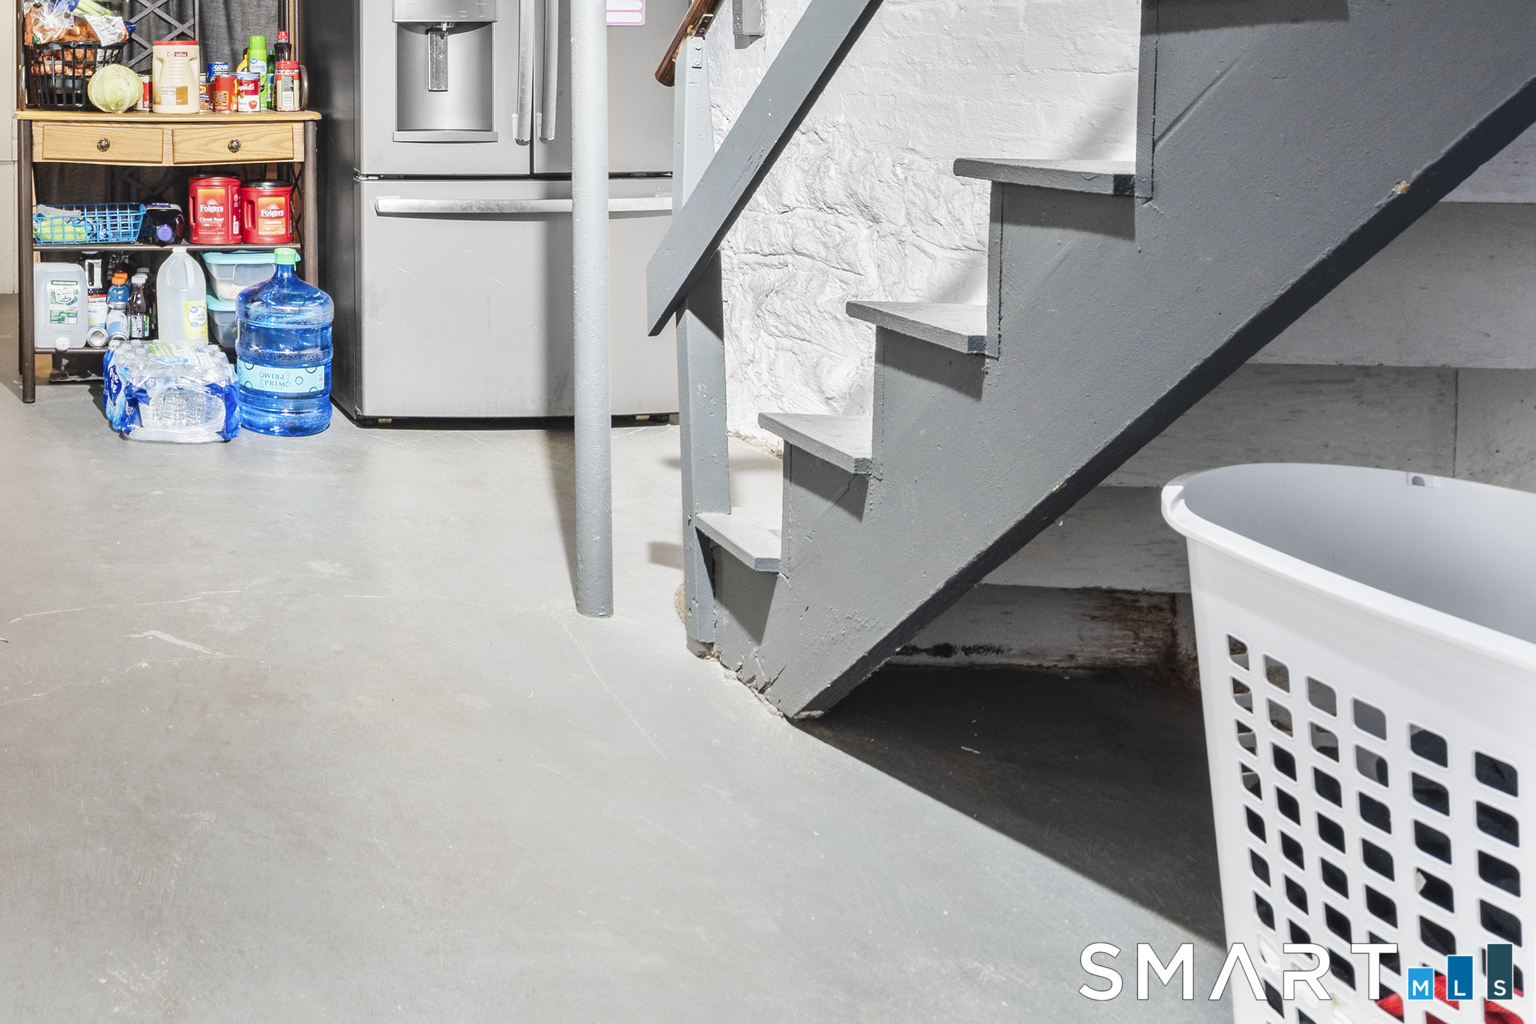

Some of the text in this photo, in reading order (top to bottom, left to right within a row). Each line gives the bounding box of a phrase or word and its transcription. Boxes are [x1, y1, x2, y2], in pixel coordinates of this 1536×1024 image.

[199, 204, 224, 213] Folgers
[260, 208, 284, 217] Folgers
[265, 379, 291, 387] PRIMO
